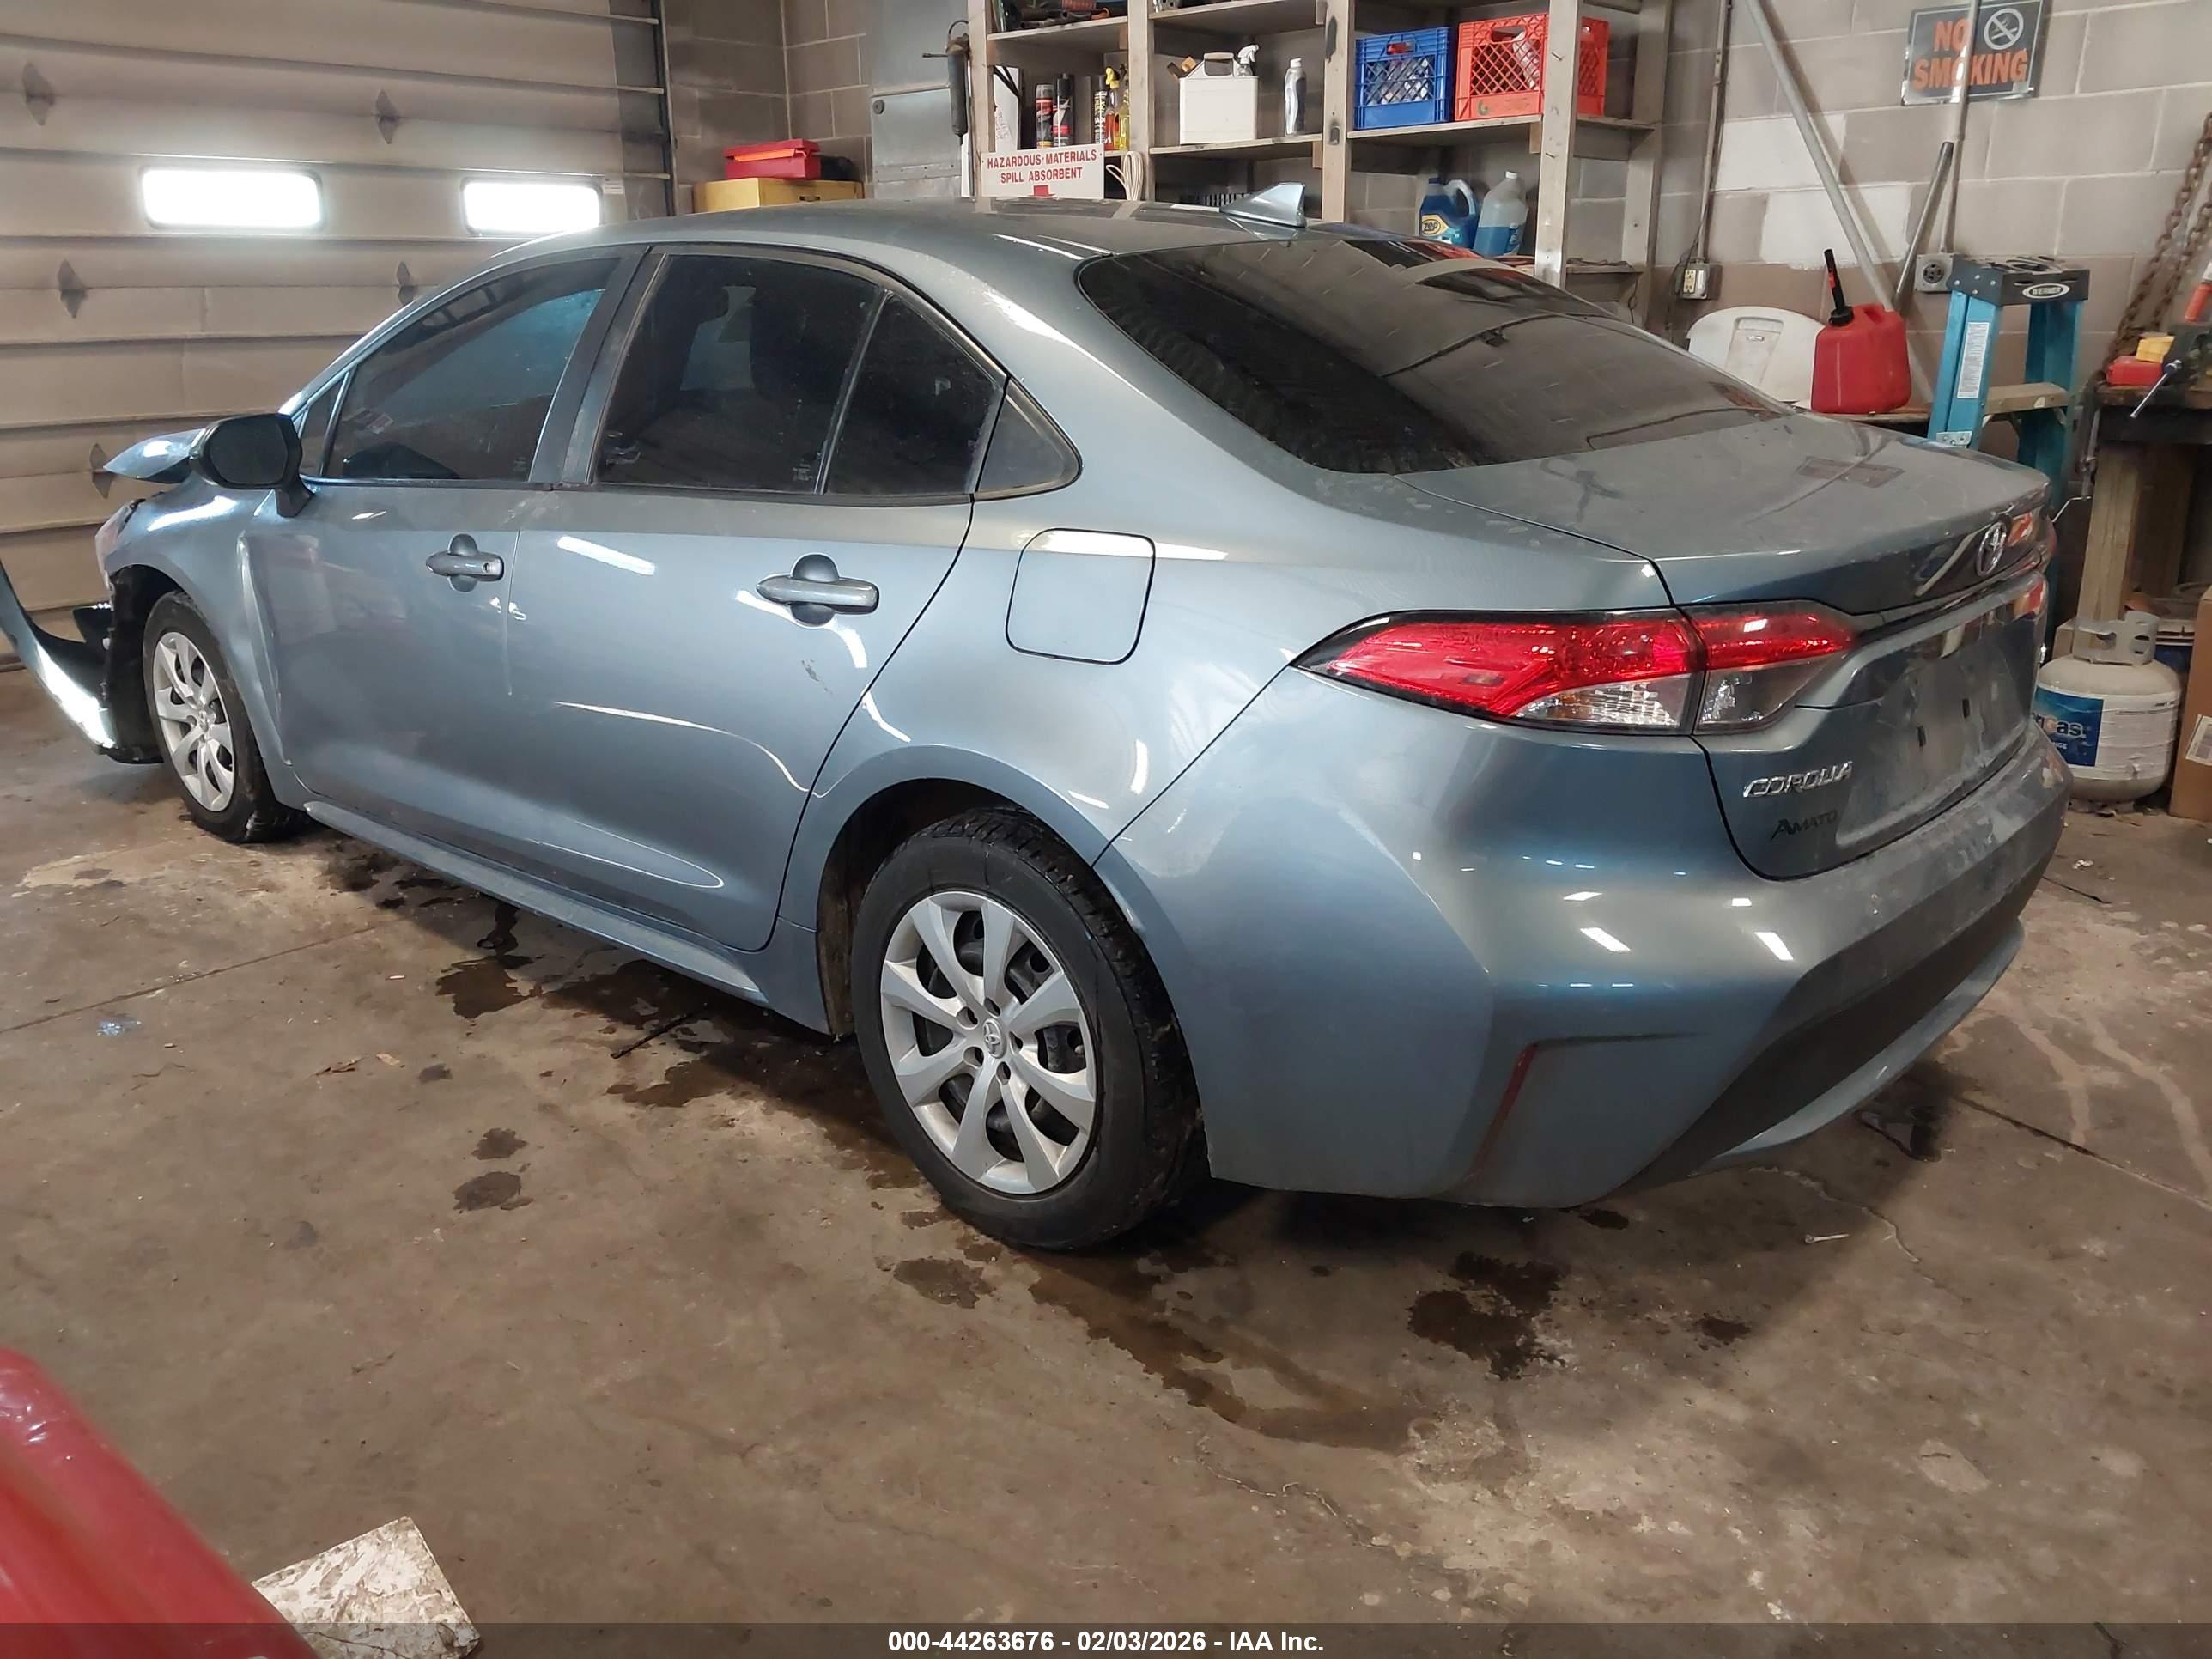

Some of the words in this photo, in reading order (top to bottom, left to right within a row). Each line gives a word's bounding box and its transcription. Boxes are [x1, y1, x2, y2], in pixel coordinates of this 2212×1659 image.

[1934, 18, 1972, 52] NO
[988, 154, 1042, 169] HAZARDOUS
[1045, 149, 1097, 165] MATERIALS
[1000, 172, 1024, 184] SPILL
[1029, 167, 1083, 182] ABSORBENT
[1742, 761, 1853, 798] COROLLA
